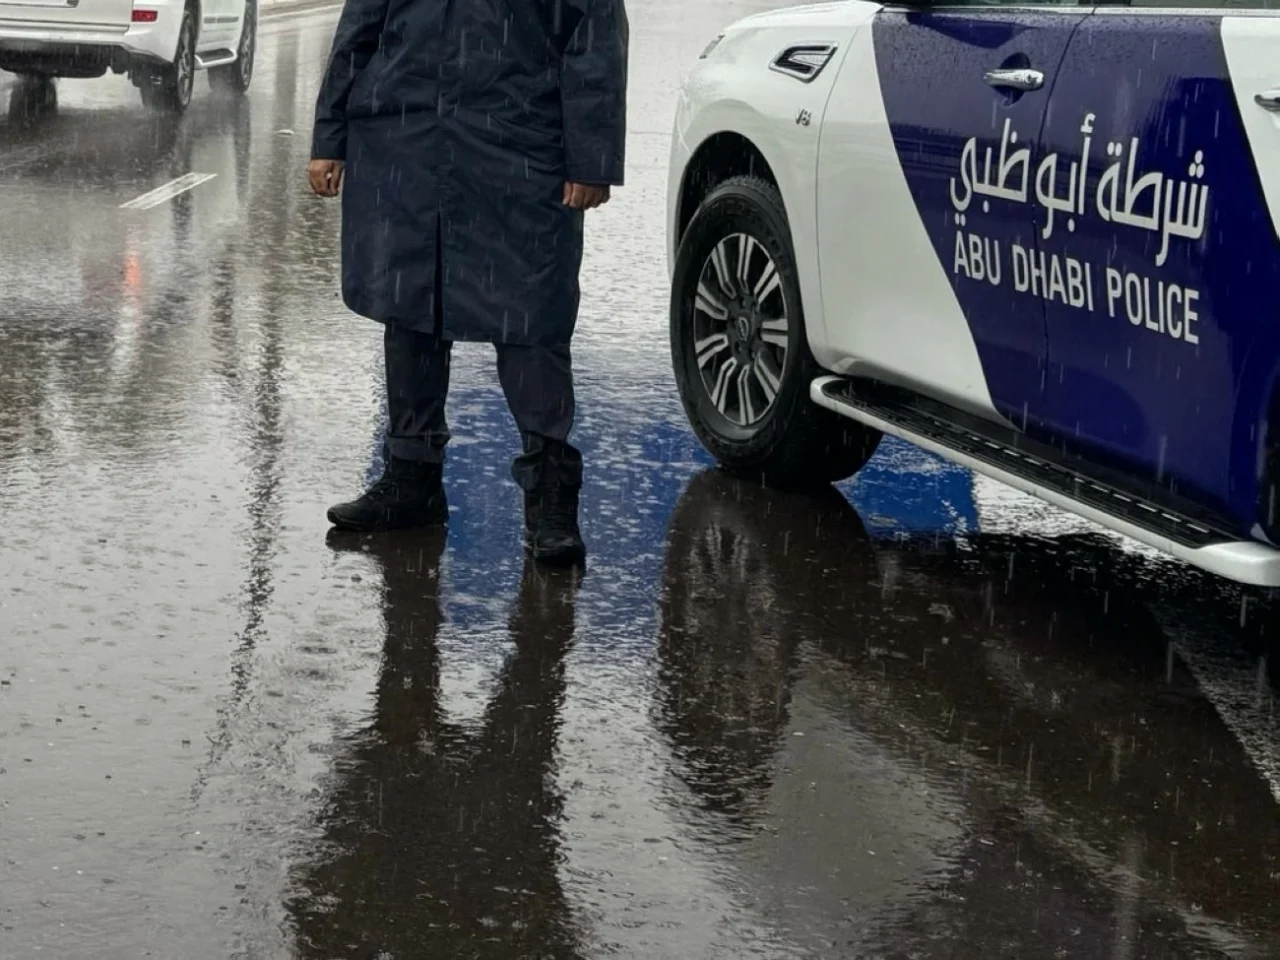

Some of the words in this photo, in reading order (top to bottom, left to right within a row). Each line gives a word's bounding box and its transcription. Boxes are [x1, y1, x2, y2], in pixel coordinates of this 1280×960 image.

[1096, 136, 1209, 267] شرطة
[954, 230, 1002, 286] ABU
[1012, 244, 1095, 312] DHABI
[1106, 267, 1200, 345] POLICE
